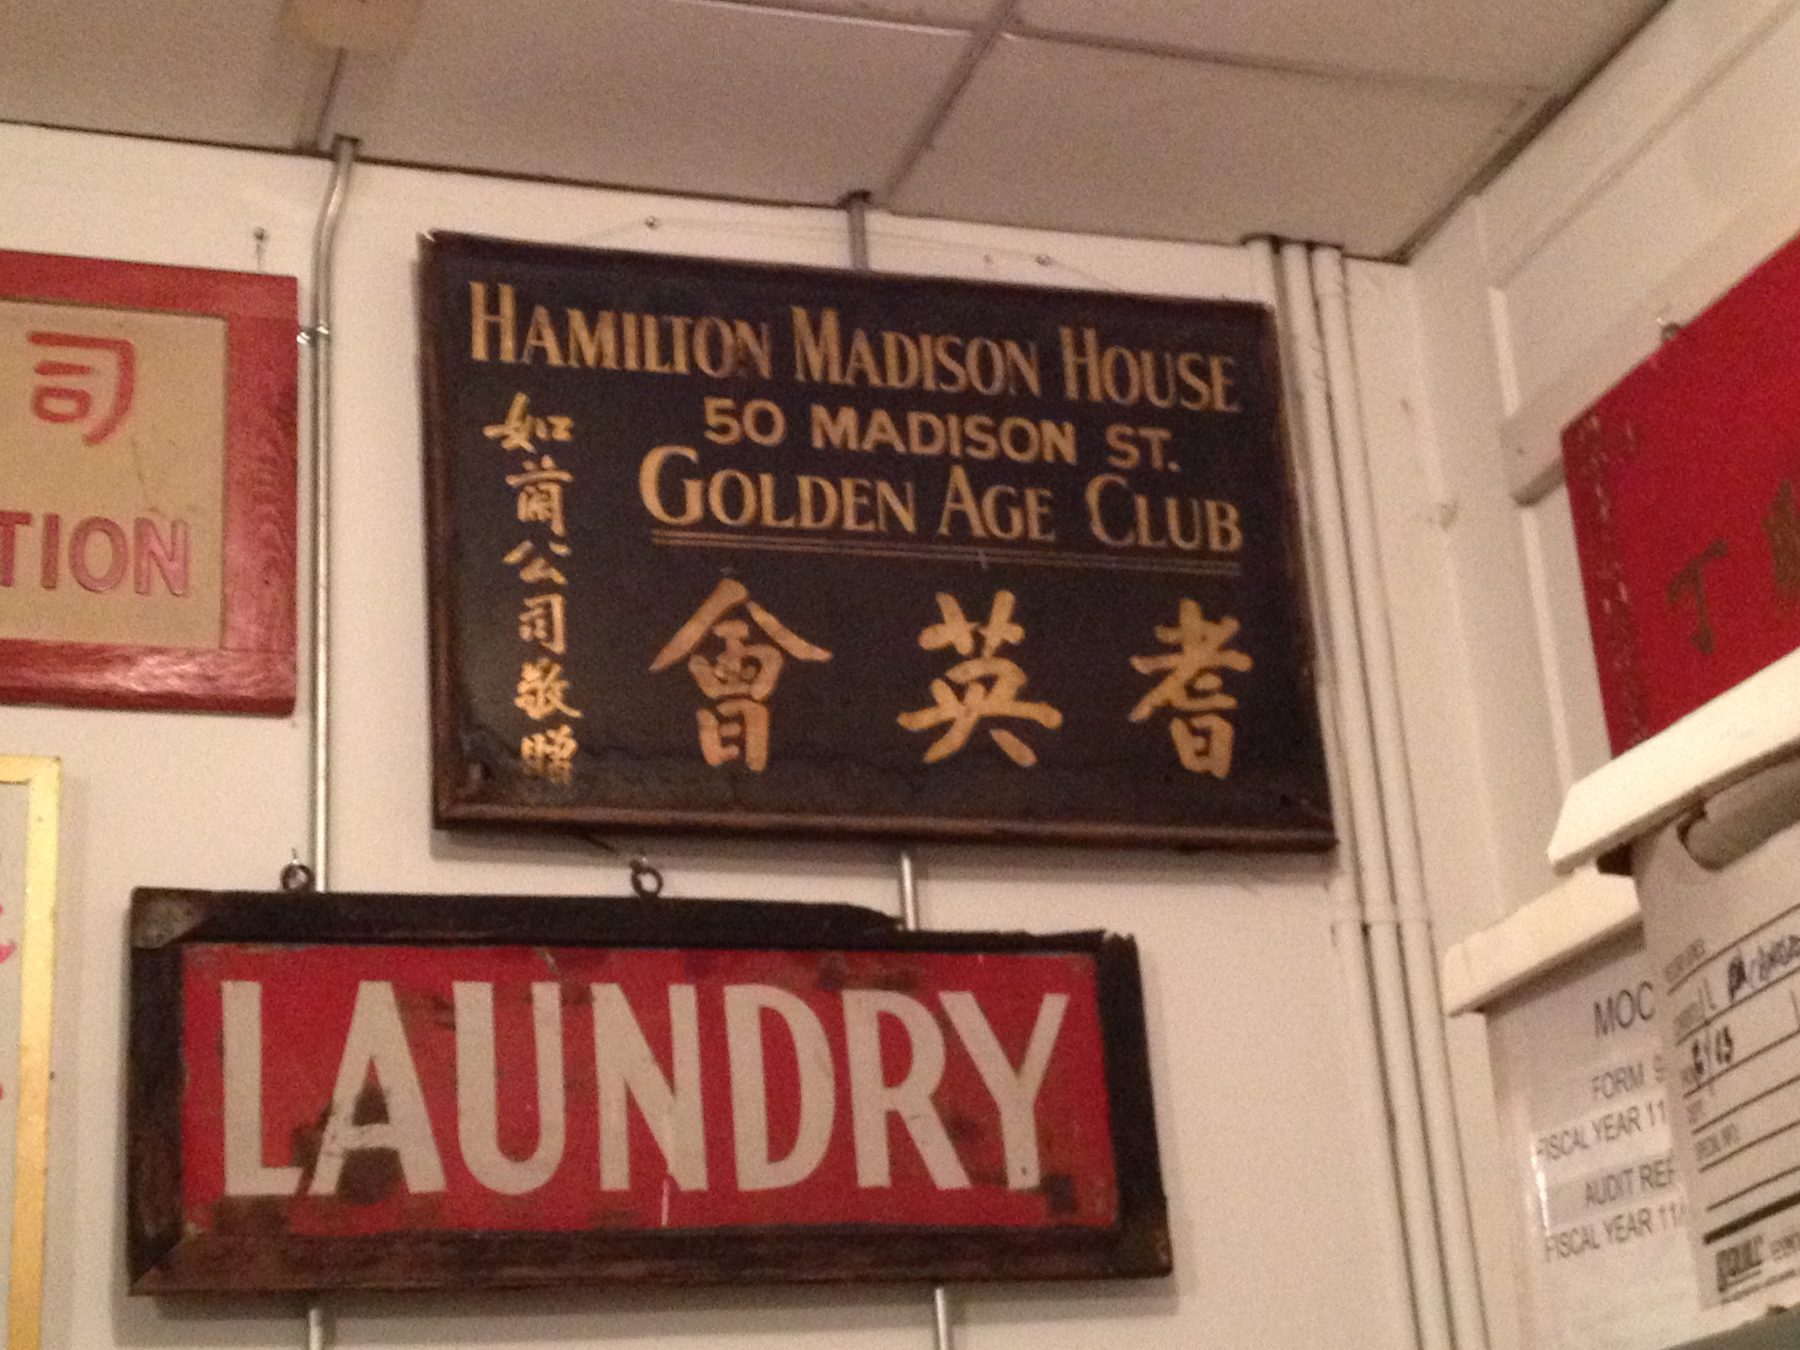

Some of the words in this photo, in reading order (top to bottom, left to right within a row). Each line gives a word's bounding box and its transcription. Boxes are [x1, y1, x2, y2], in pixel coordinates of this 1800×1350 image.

[469, 280, 773, 381] HAMILTON
[790, 305, 1041, 399] MADISON
[1058, 325, 1243, 413] HOUSE
[703, 396, 786, 445] 50
[811, 403, 1077, 465] MADISON
[1105, 423, 1181, 473] ST.
[639, 444, 918, 535] GOLDEN
[937, 465, 1057, 543] AGE
[1084, 474, 1243, 553] CLUB
[1594, 980, 1656, 1038] MOC
[220, 980, 1069, 1198] LAUNDRY
[1592, 1062, 1645, 1100] FORM
[1537, 1126, 1589, 1161] FISCAL
[1592, 1105, 1642, 1143] YEAR
[1585, 1167, 1633, 1206] AUDIT
[1546, 1225, 1600, 1263] FISCAL
[1603, 1206, 1653, 1243] YEAR
